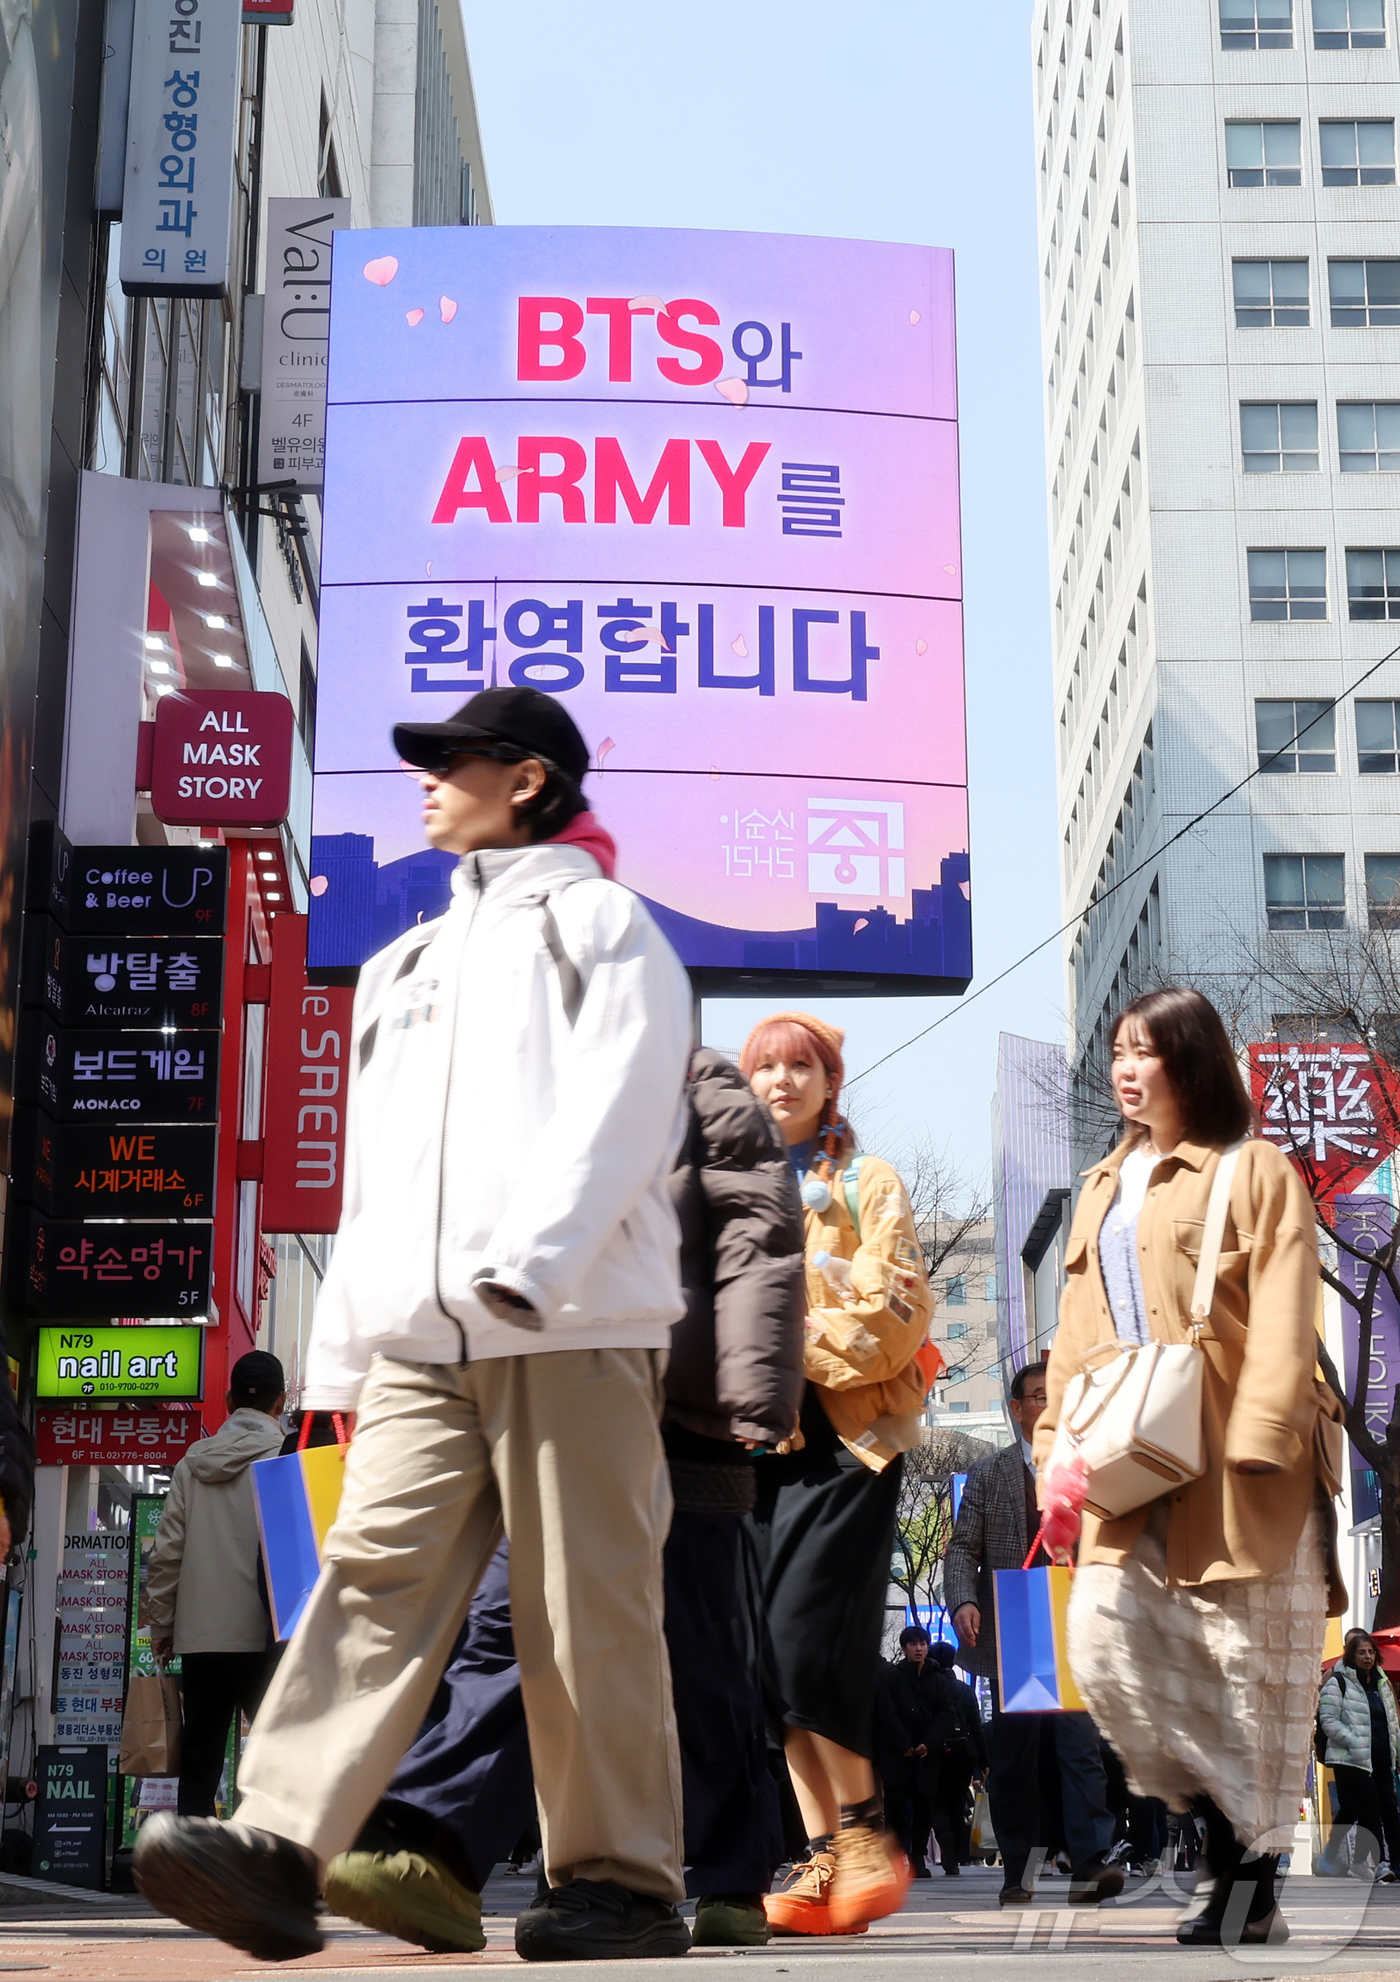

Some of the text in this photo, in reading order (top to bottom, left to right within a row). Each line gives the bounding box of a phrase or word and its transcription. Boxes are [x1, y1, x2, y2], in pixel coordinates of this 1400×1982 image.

[155, 70, 200, 237] 성형외과
[516, 295, 803, 393] BTS와
[292, 413, 313, 428] 4F
[431, 435, 846, 539] ARMY를
[404, 597, 881, 702] 환영합니다
[199, 711, 249, 733] ALL
[182, 742, 261, 767] MASK
[177, 776, 263, 800] STORY
[720, 808, 795, 841] 이순신
[721, 844, 795, 879] 1545
[85, 868, 153, 885] Coffee
[85, 892, 99, 908] &
[106, 892, 151, 908] Beer
[195, 909, 213, 923] 9F
[86, 952, 201, 992] 방탈출
[85, 1003, 150, 1016] Alcatraz
[191, 1002, 209, 1016] 8F
[72, 1098, 141, 1110] MONACO
[188, 1097, 205, 1110] 7F
[109, 1135, 156, 1161] WE
[75, 1168, 186, 1193] 시계거래소
[183, 1193, 204, 1207] 6F
[56, 1238, 202, 1280] 약손명가
[178, 1291, 199, 1305] 5F
[60, 1334, 94, 1348] N79
[58, 1350, 178, 1378] nail art
[100, 1382, 159, 1391] 010-9700-0279
[52, 1416, 189, 1446] 현대 부동산
[72, 1450, 85, 1460] 6F
[89, 1451, 105, 1460] TEL
[89, 1559, 107, 1568] ALL
[62, 1569, 93, 1579] MASK
[88, 1586, 106, 1595] ALL
[62, 1597, 92, 1606] MASK
[87, 1613, 105, 1622] ALL
[61, 1624, 91, 1633] MASK
[85, 1641, 103, 1649] ALL
[60, 1651, 89, 1661] MASK
[60, 1668, 83, 1679] 동진
[72, 1697, 97, 1713] 현대
[48, 1765, 74, 1777] N79
[46, 1781, 95, 1798] NAIL
